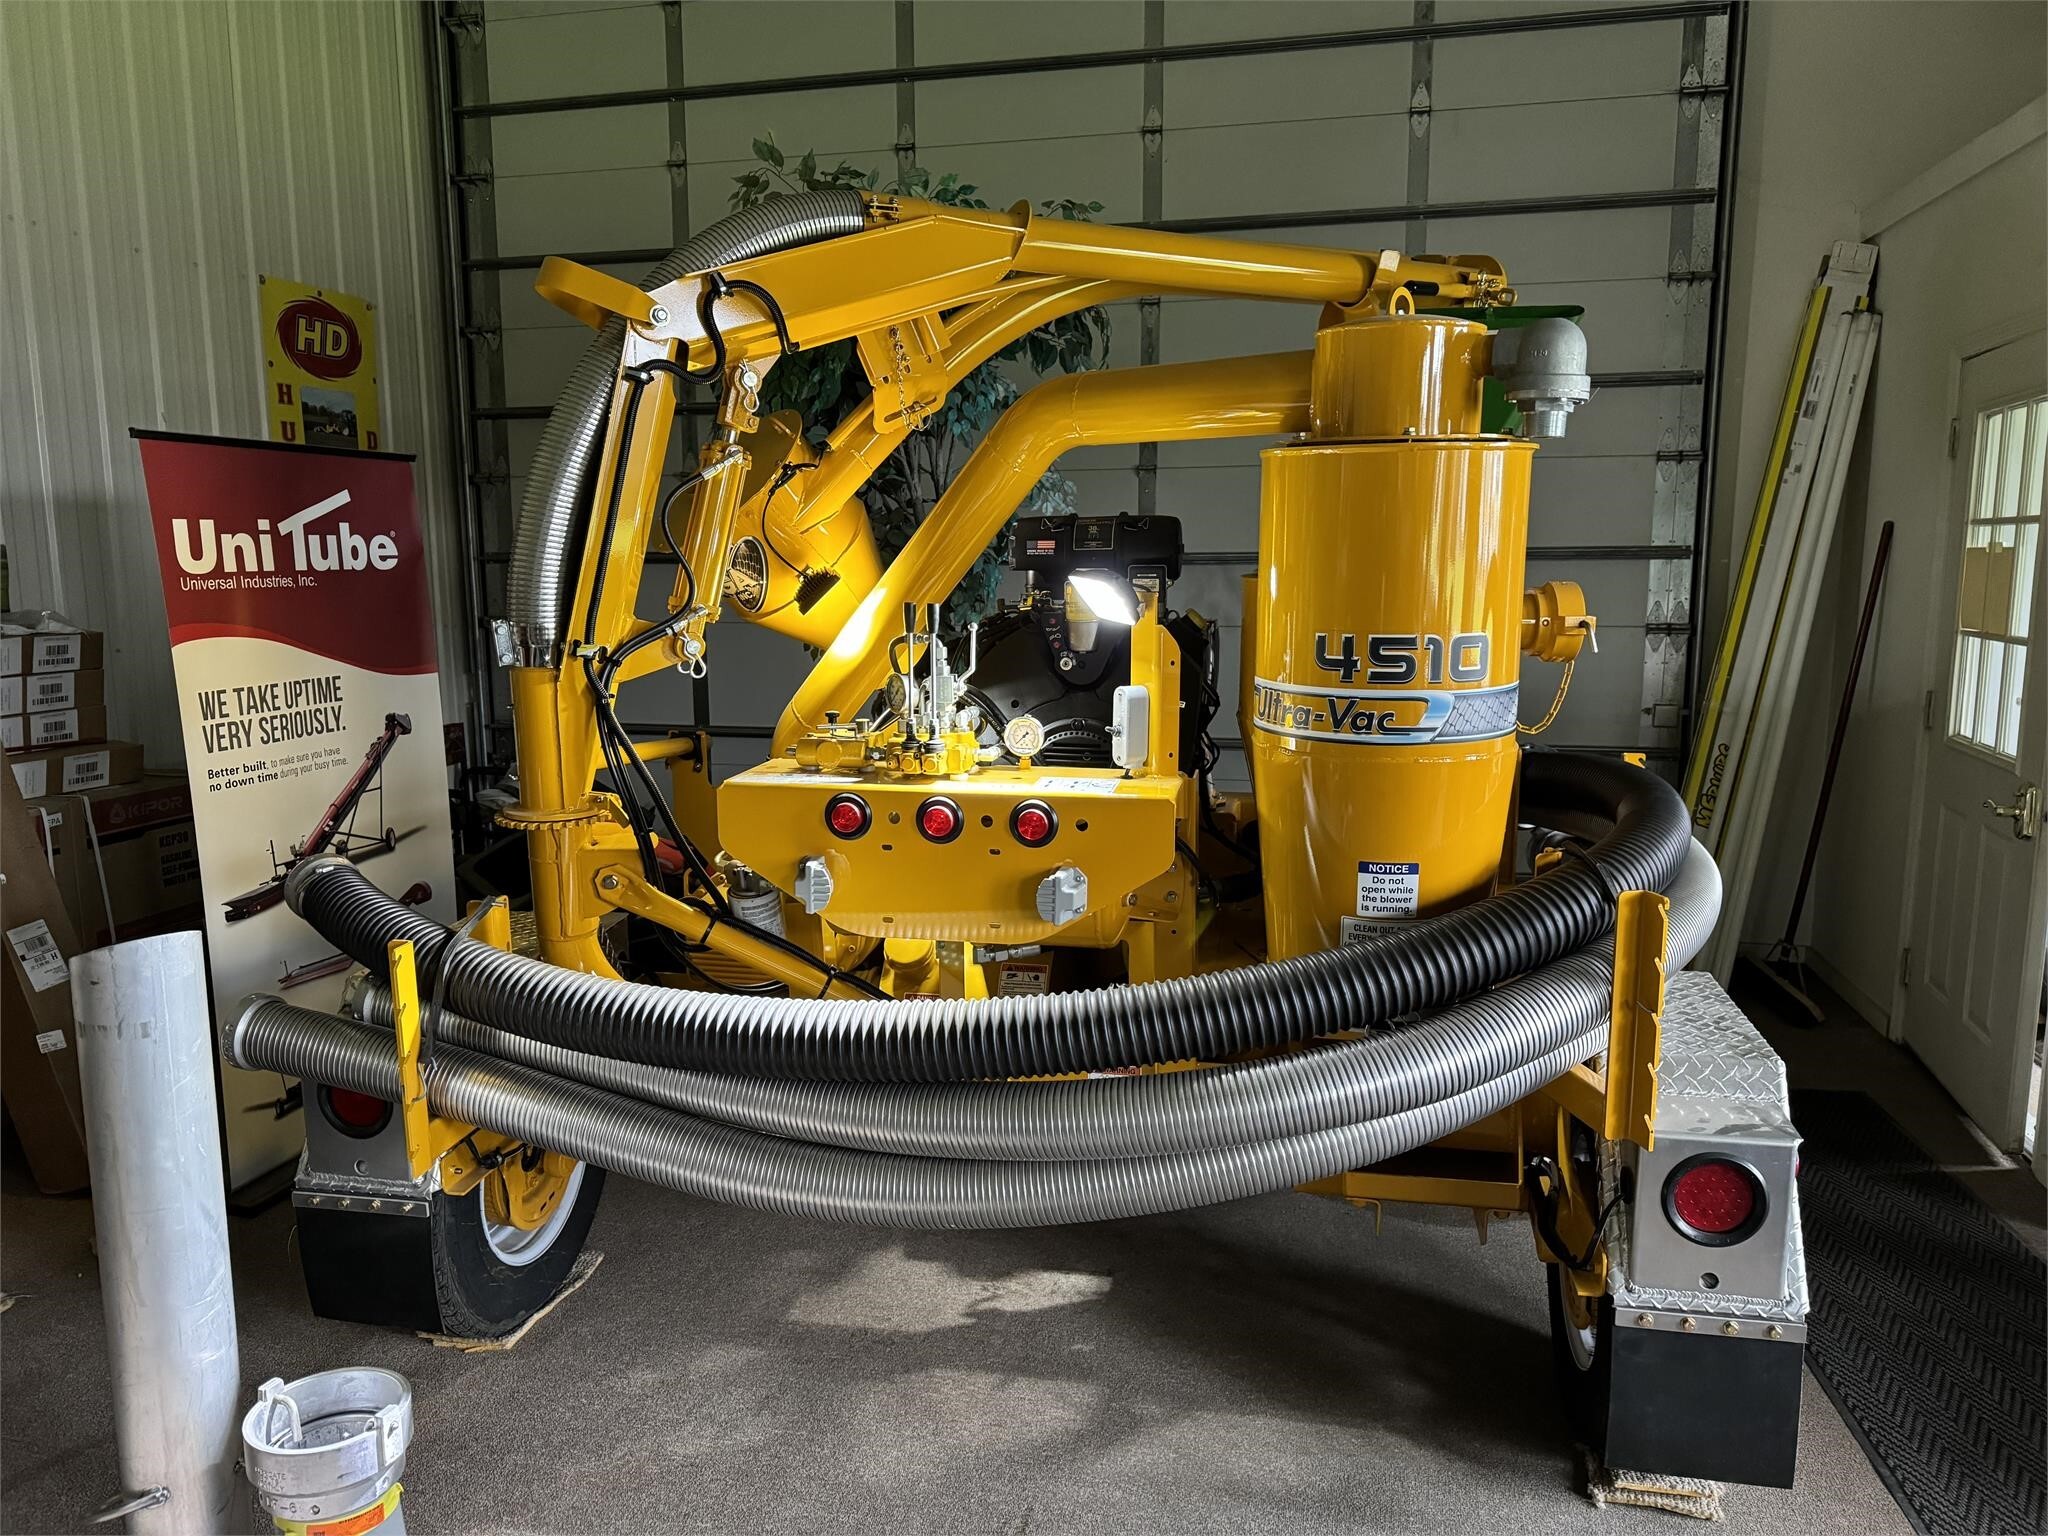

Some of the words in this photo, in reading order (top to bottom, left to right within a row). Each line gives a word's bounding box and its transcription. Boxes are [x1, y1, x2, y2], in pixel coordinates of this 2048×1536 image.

[295, 314, 350, 359] HD
[180, 576, 237, 591] Universal
[240, 574, 296, 590] Industries,
[298, 574, 318, 588] Inc.
[1314, 632, 1490, 684] 4510
[198, 689, 230, 721] WE
[232, 683, 281, 716] TAKE
[283, 675, 344, 710] UPTIME
[1256, 685, 1397, 735] Ultra-Vac
[202, 718, 252, 754] VERY
[258, 705, 346, 745] SERIOUSLY.
[207, 765, 240, 780] Better
[270, 759, 278, 769] to
[279, 755, 295, 766] make
[296, 752, 310, 762] sure
[311, 750, 323, 763] you
[323, 746, 341, 757] have
[209, 782, 222, 792] no
[224, 776, 255, 790] down
[257, 770, 279, 783] time
[279, 765, 299, 779] during
[299, 763, 313, 776] your
[314, 759, 330, 772] busy
[331, 756, 349, 768] time.
[1368, 864, 1410, 874] NOTICE
[1372, 876, 1386, 885] Do
[1388, 877, 1405, 885] not
[1361, 886, 1386, 895] open
[1388, 886, 1414, 894] while
[1361, 894, 1378, 903] the
[1379, 895, 1413, 904] blower
[1361, 904, 1370, 912] is
[1372, 905, 1413, 915] running.
[1353, 923, 1378, 933] CLEAN
